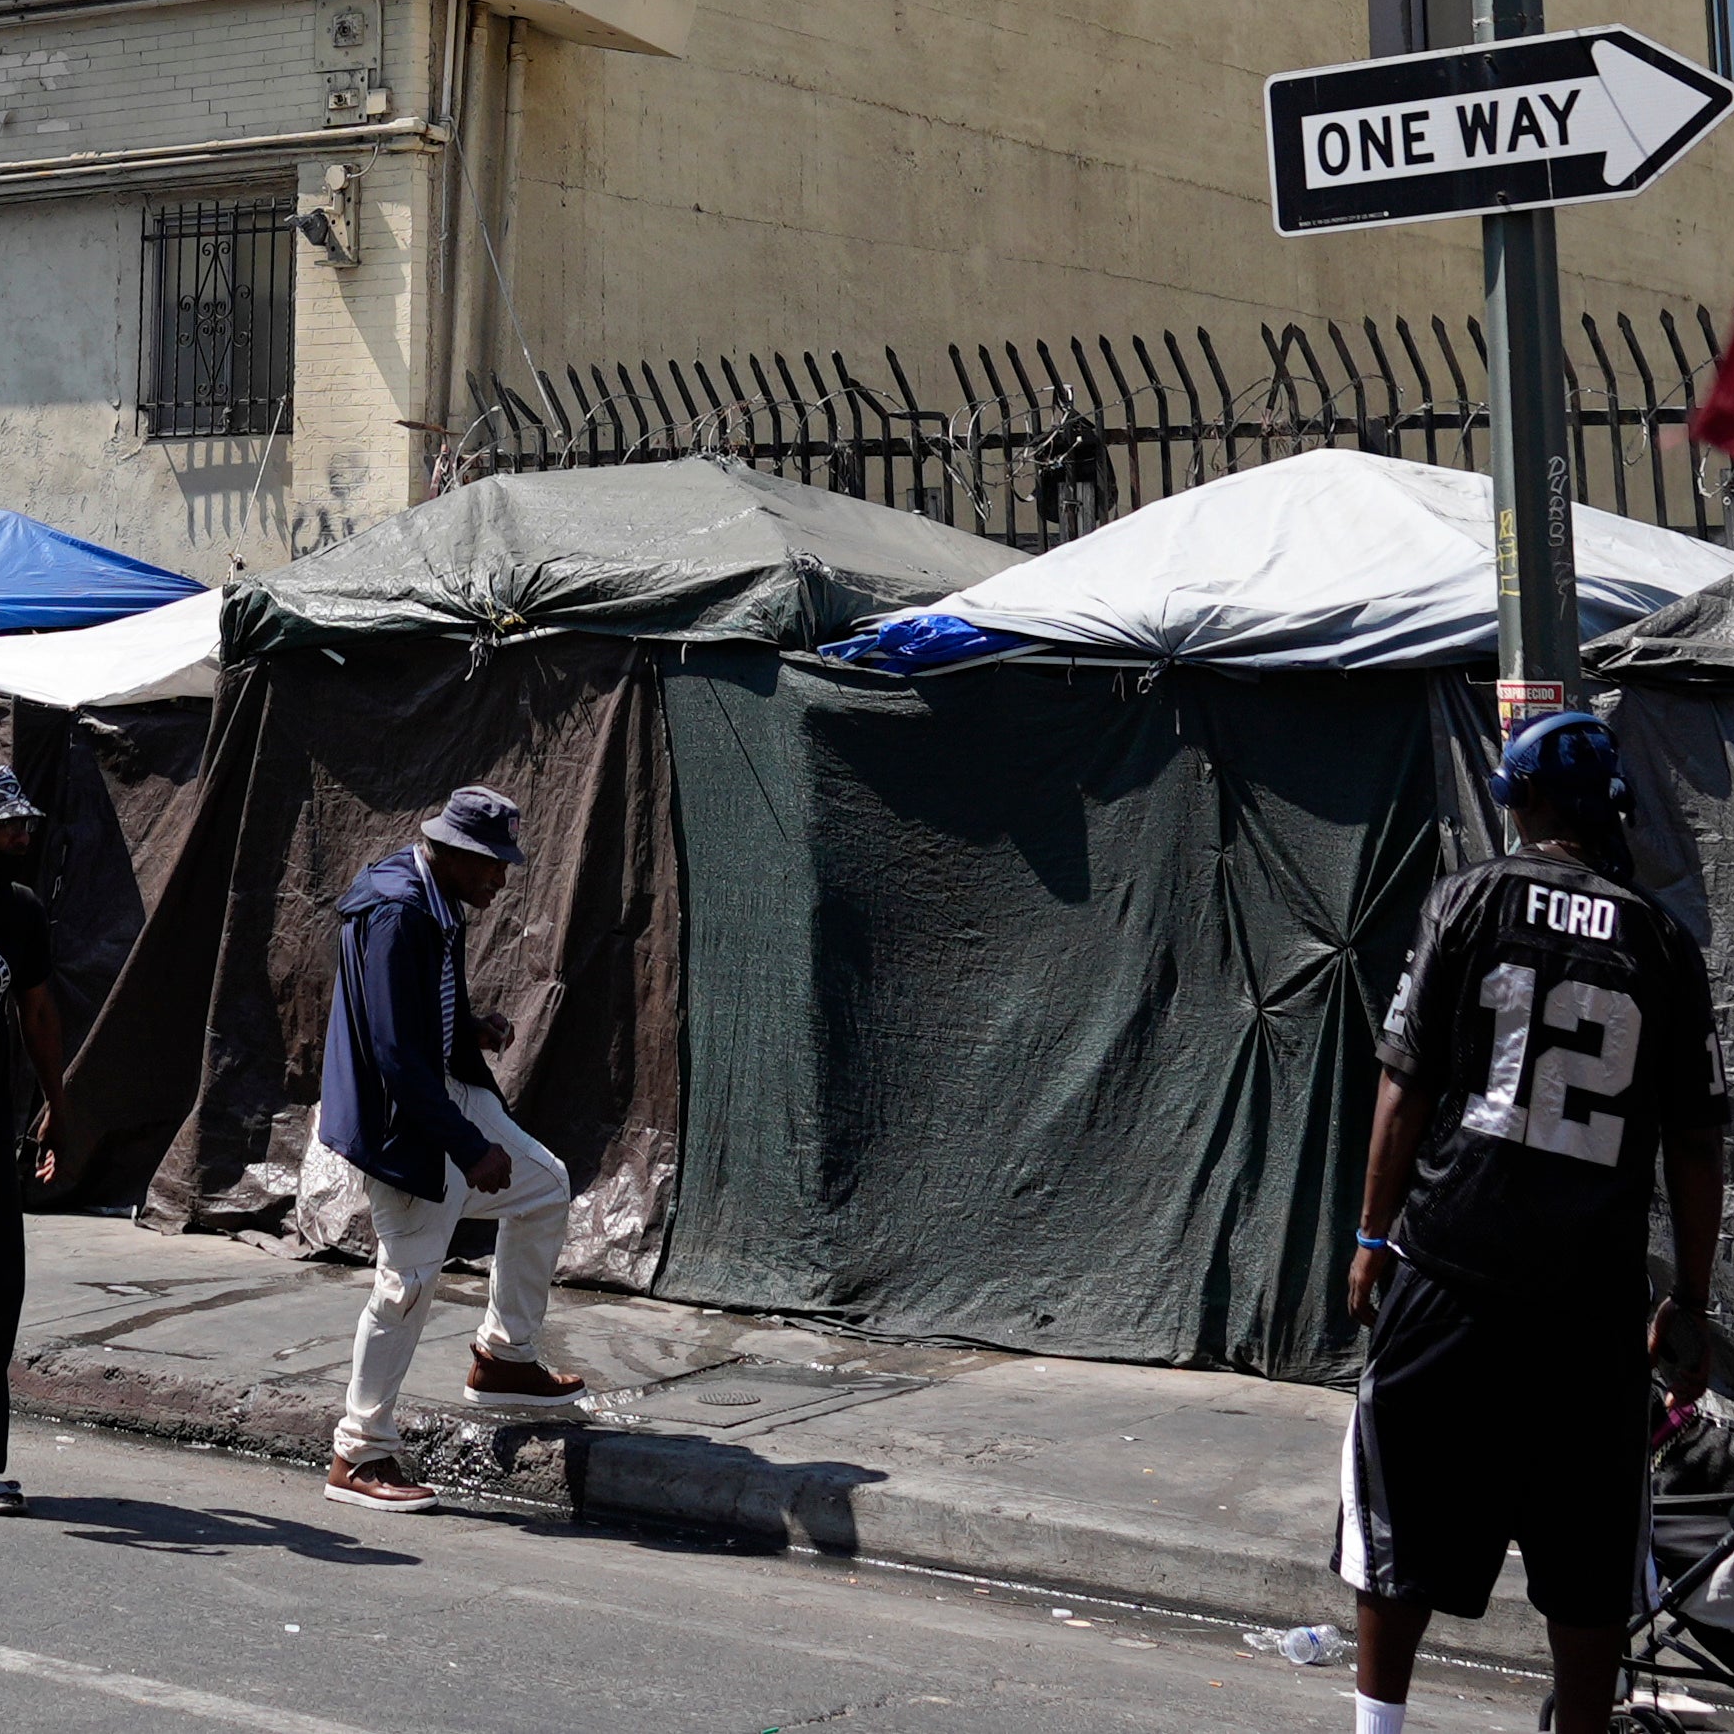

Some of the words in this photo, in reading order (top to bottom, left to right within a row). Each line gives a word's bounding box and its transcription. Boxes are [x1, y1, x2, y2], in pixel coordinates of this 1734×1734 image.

[1317, 110, 1435, 177] ONE
[1455, 88, 1582, 159] WAY
[1525, 883, 1615, 941] FORD
[1461, 961, 1643, 1168] 12
